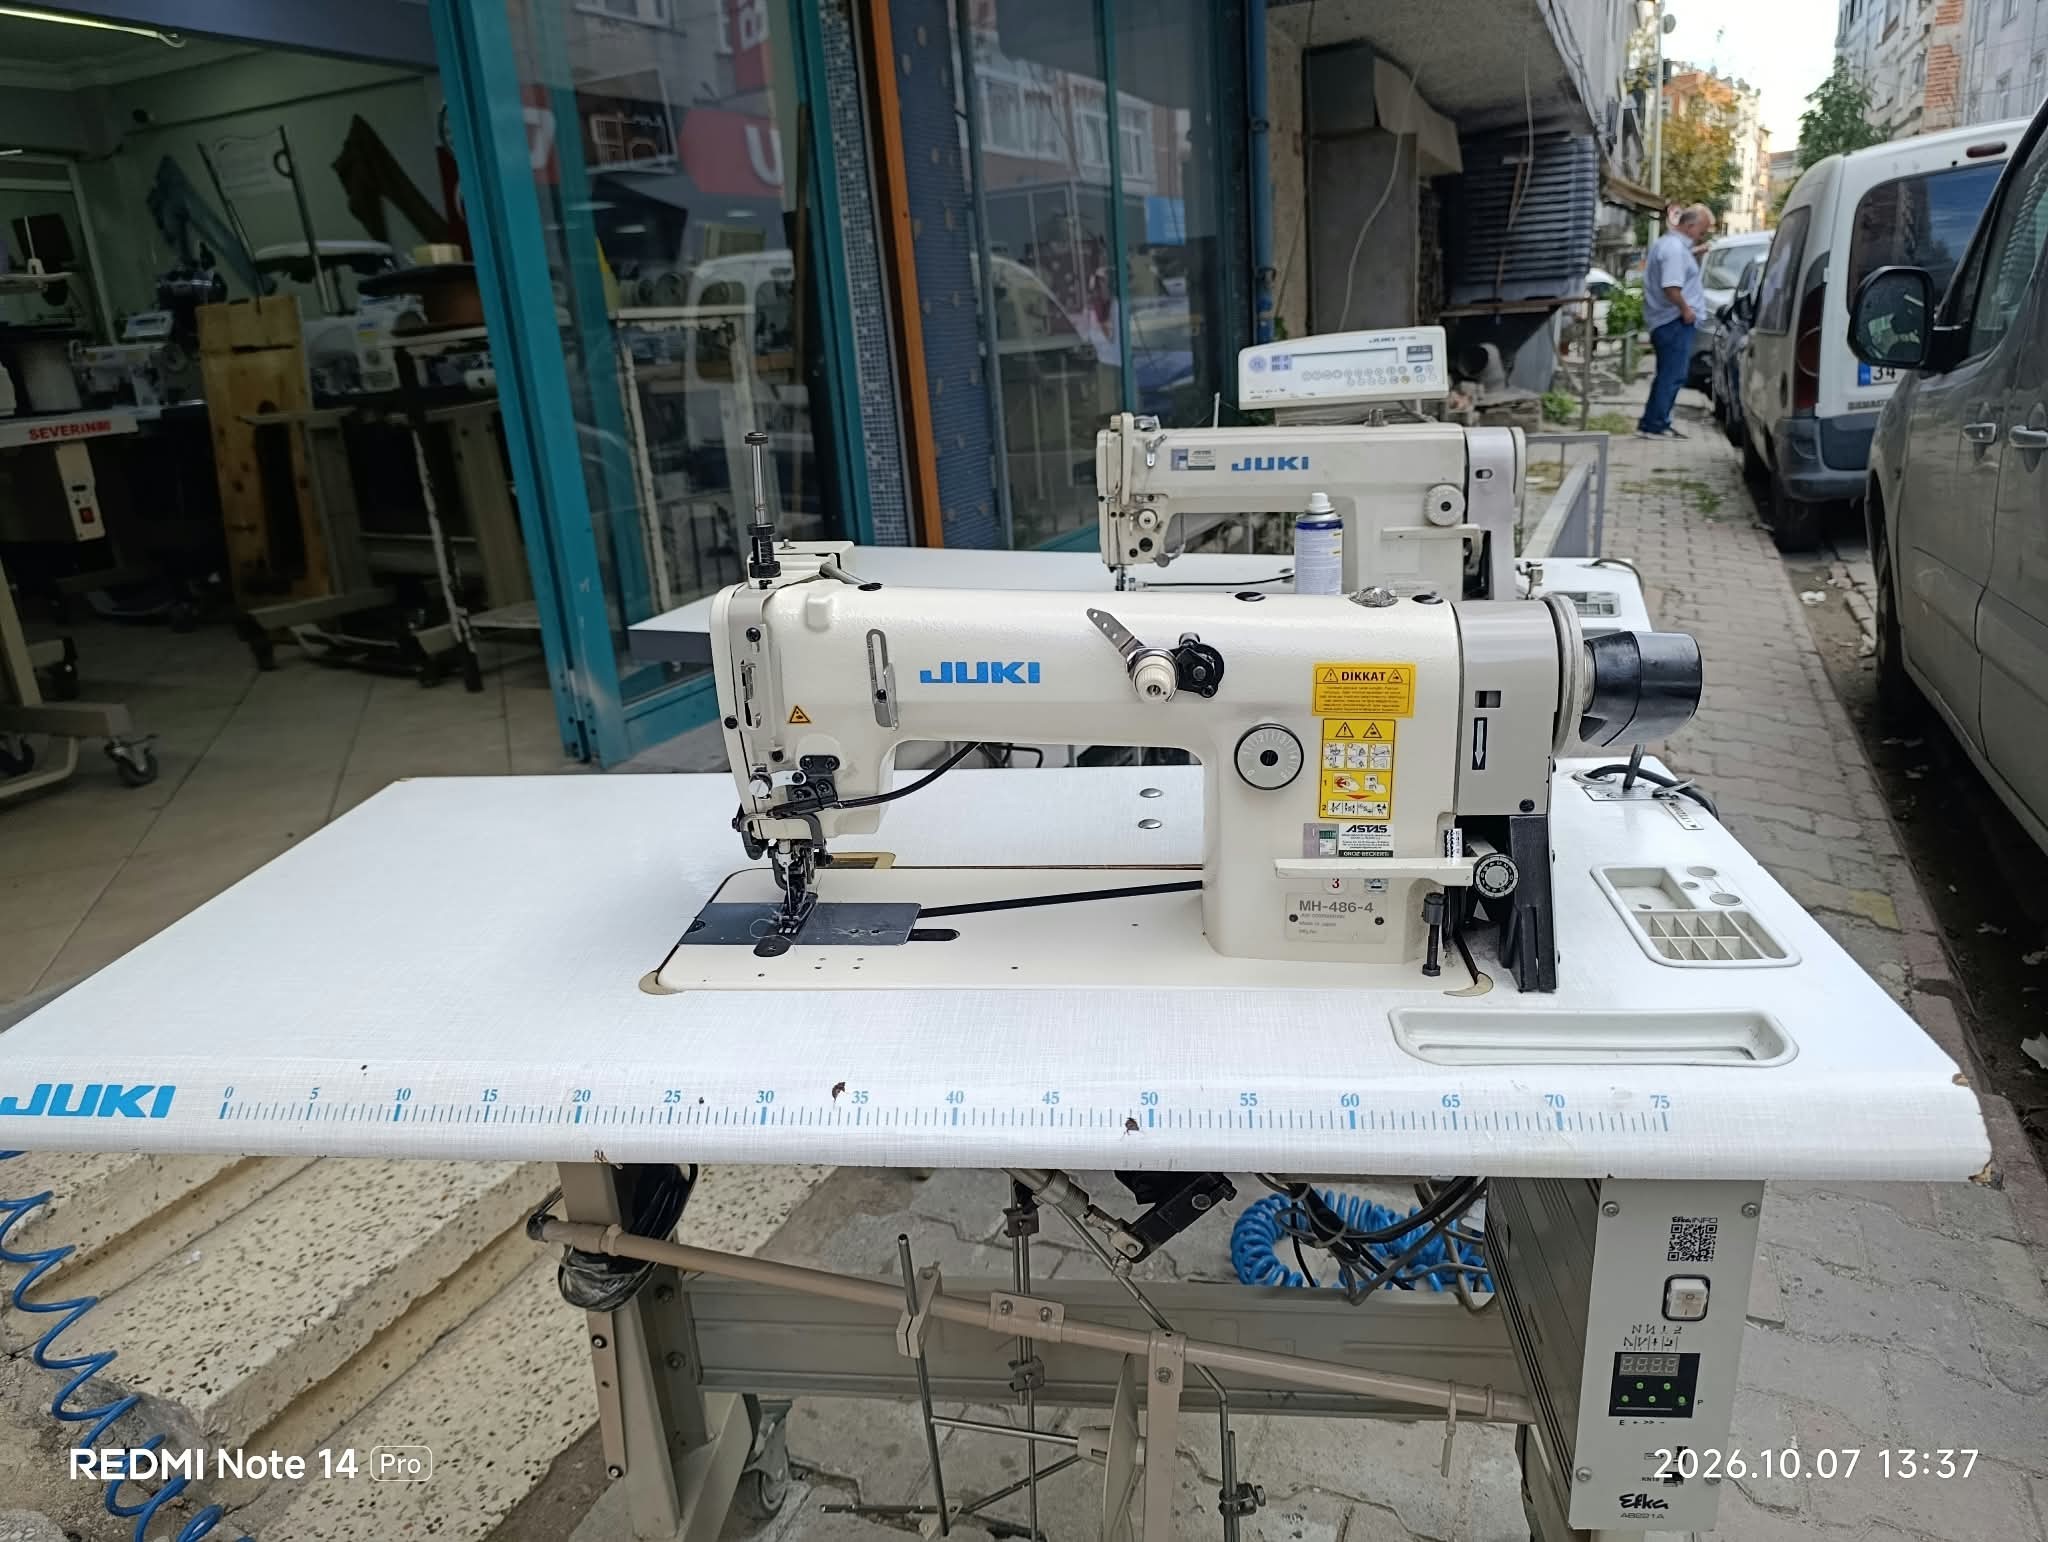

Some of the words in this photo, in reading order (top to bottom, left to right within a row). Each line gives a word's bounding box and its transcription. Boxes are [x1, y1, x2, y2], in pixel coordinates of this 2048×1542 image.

[1232, 457, 1309, 472] JUKI
[919, 661, 1040, 684] JUKI
[1299, 900, 1374, 913] MH-486-4
[0, 1083, 177, 1119] JUKI
[224, 1087, 233, 1098] 0
[310, 1087, 320, 1100] 5
[396, 1088, 411, 1101] 10
[483, 1088, 498, 1102] 15
[572, 1089, 591, 1103] 20
[664, 1090, 682, 1104] 25
[756, 1090, 774, 1104] 30
[852, 1091, 869, 1105] 35
[945, 1091, 964, 1105] 40
[1042, 1091, 1060, 1105] 45
[1140, 1092, 1159, 1106] 50
[1240, 1092, 1258, 1107] 55
[1340, 1093, 1360, 1107] 60
[1441, 1094, 1460, 1108] 65
[1545, 1094, 1565, 1109] 70
[1650, 1095, 1670, 1110] 75
[1619, 1493, 1669, 1509] Efka
